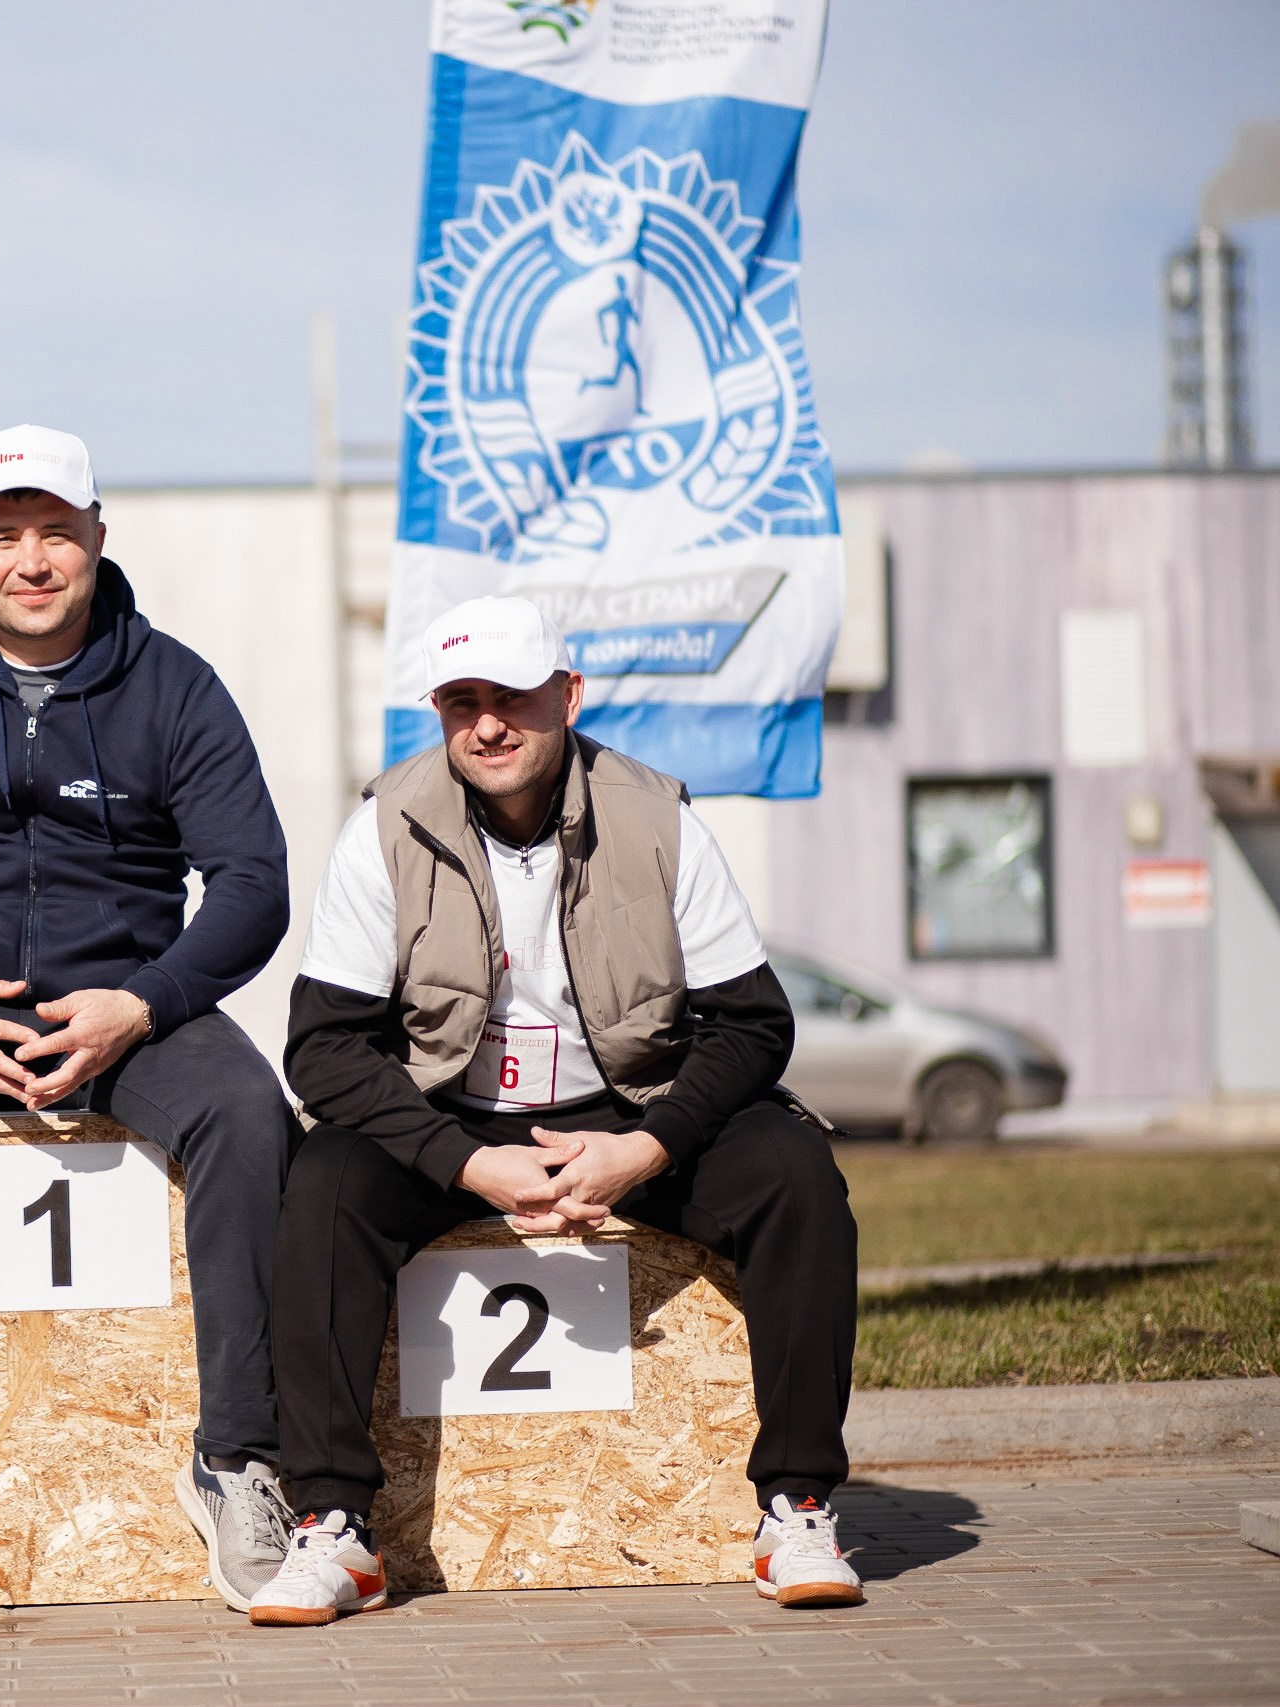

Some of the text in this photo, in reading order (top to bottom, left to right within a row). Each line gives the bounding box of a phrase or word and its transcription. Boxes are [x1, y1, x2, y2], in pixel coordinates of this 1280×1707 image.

[499, 1055, 520, 1090] 6
[23, 1179, 72, 1287] 1
[480, 1282, 552, 1392] 2
